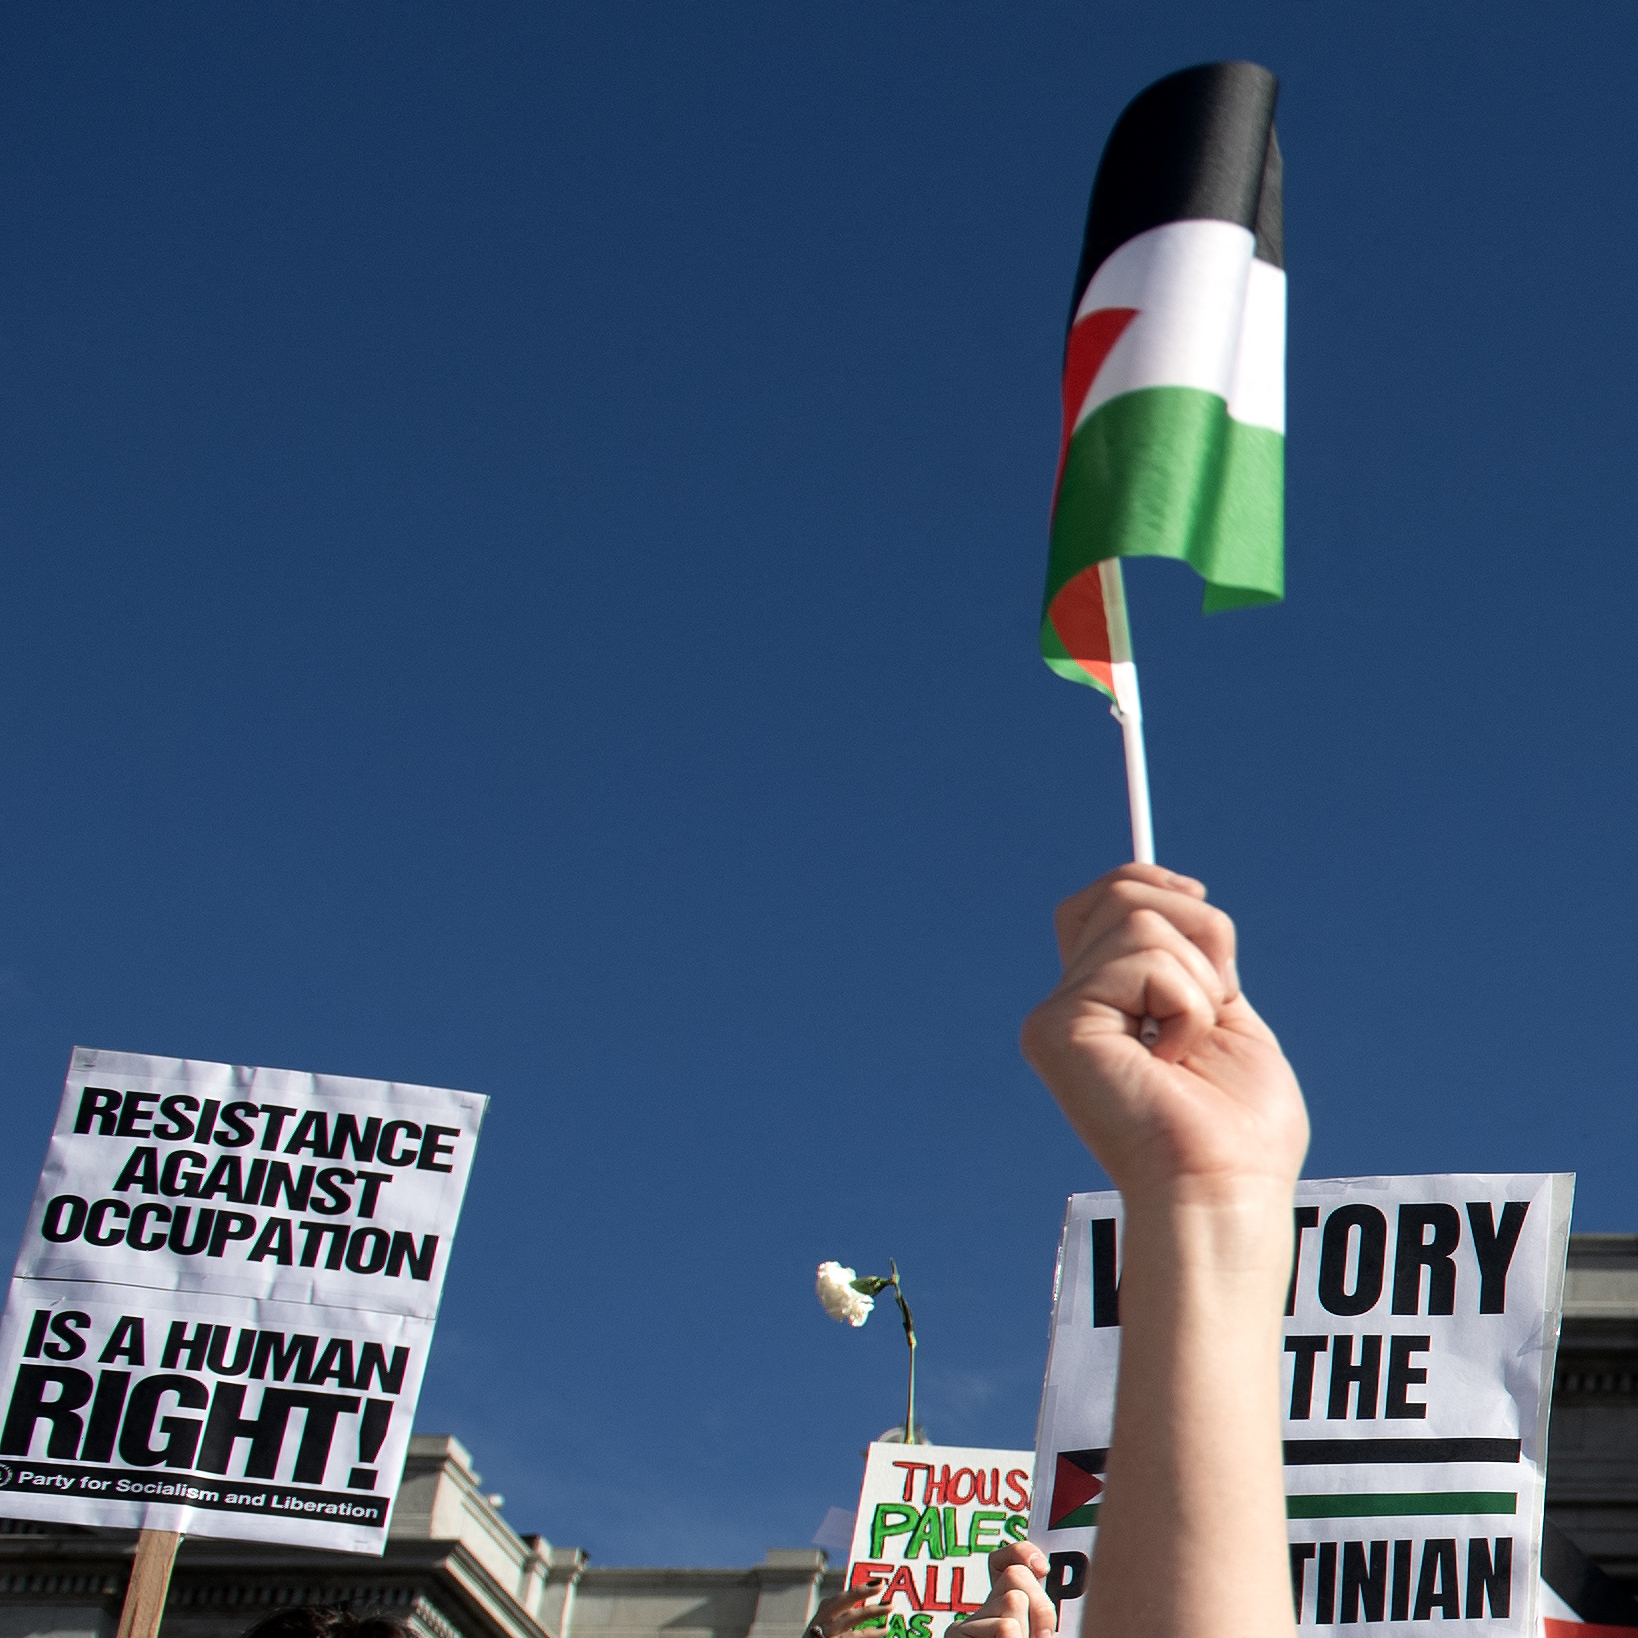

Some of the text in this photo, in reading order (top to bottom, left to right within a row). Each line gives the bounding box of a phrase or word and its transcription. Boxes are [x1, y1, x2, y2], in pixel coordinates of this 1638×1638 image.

[74, 1086, 461, 1173] RESISTANCE
[113, 1146, 393, 1218] AGAINST
[41, 1195, 438, 1281] OCCUPATION
[23, 1309, 410, 1394] IS A HUMAN
[1284, 1335, 1430, 1420] THE
[0, 1364, 395, 1490] RIGHT!
[18, 1471, 379, 1519] Party for Socialism and Liberation
[893, 1461, 1031, 1512] THOUS
